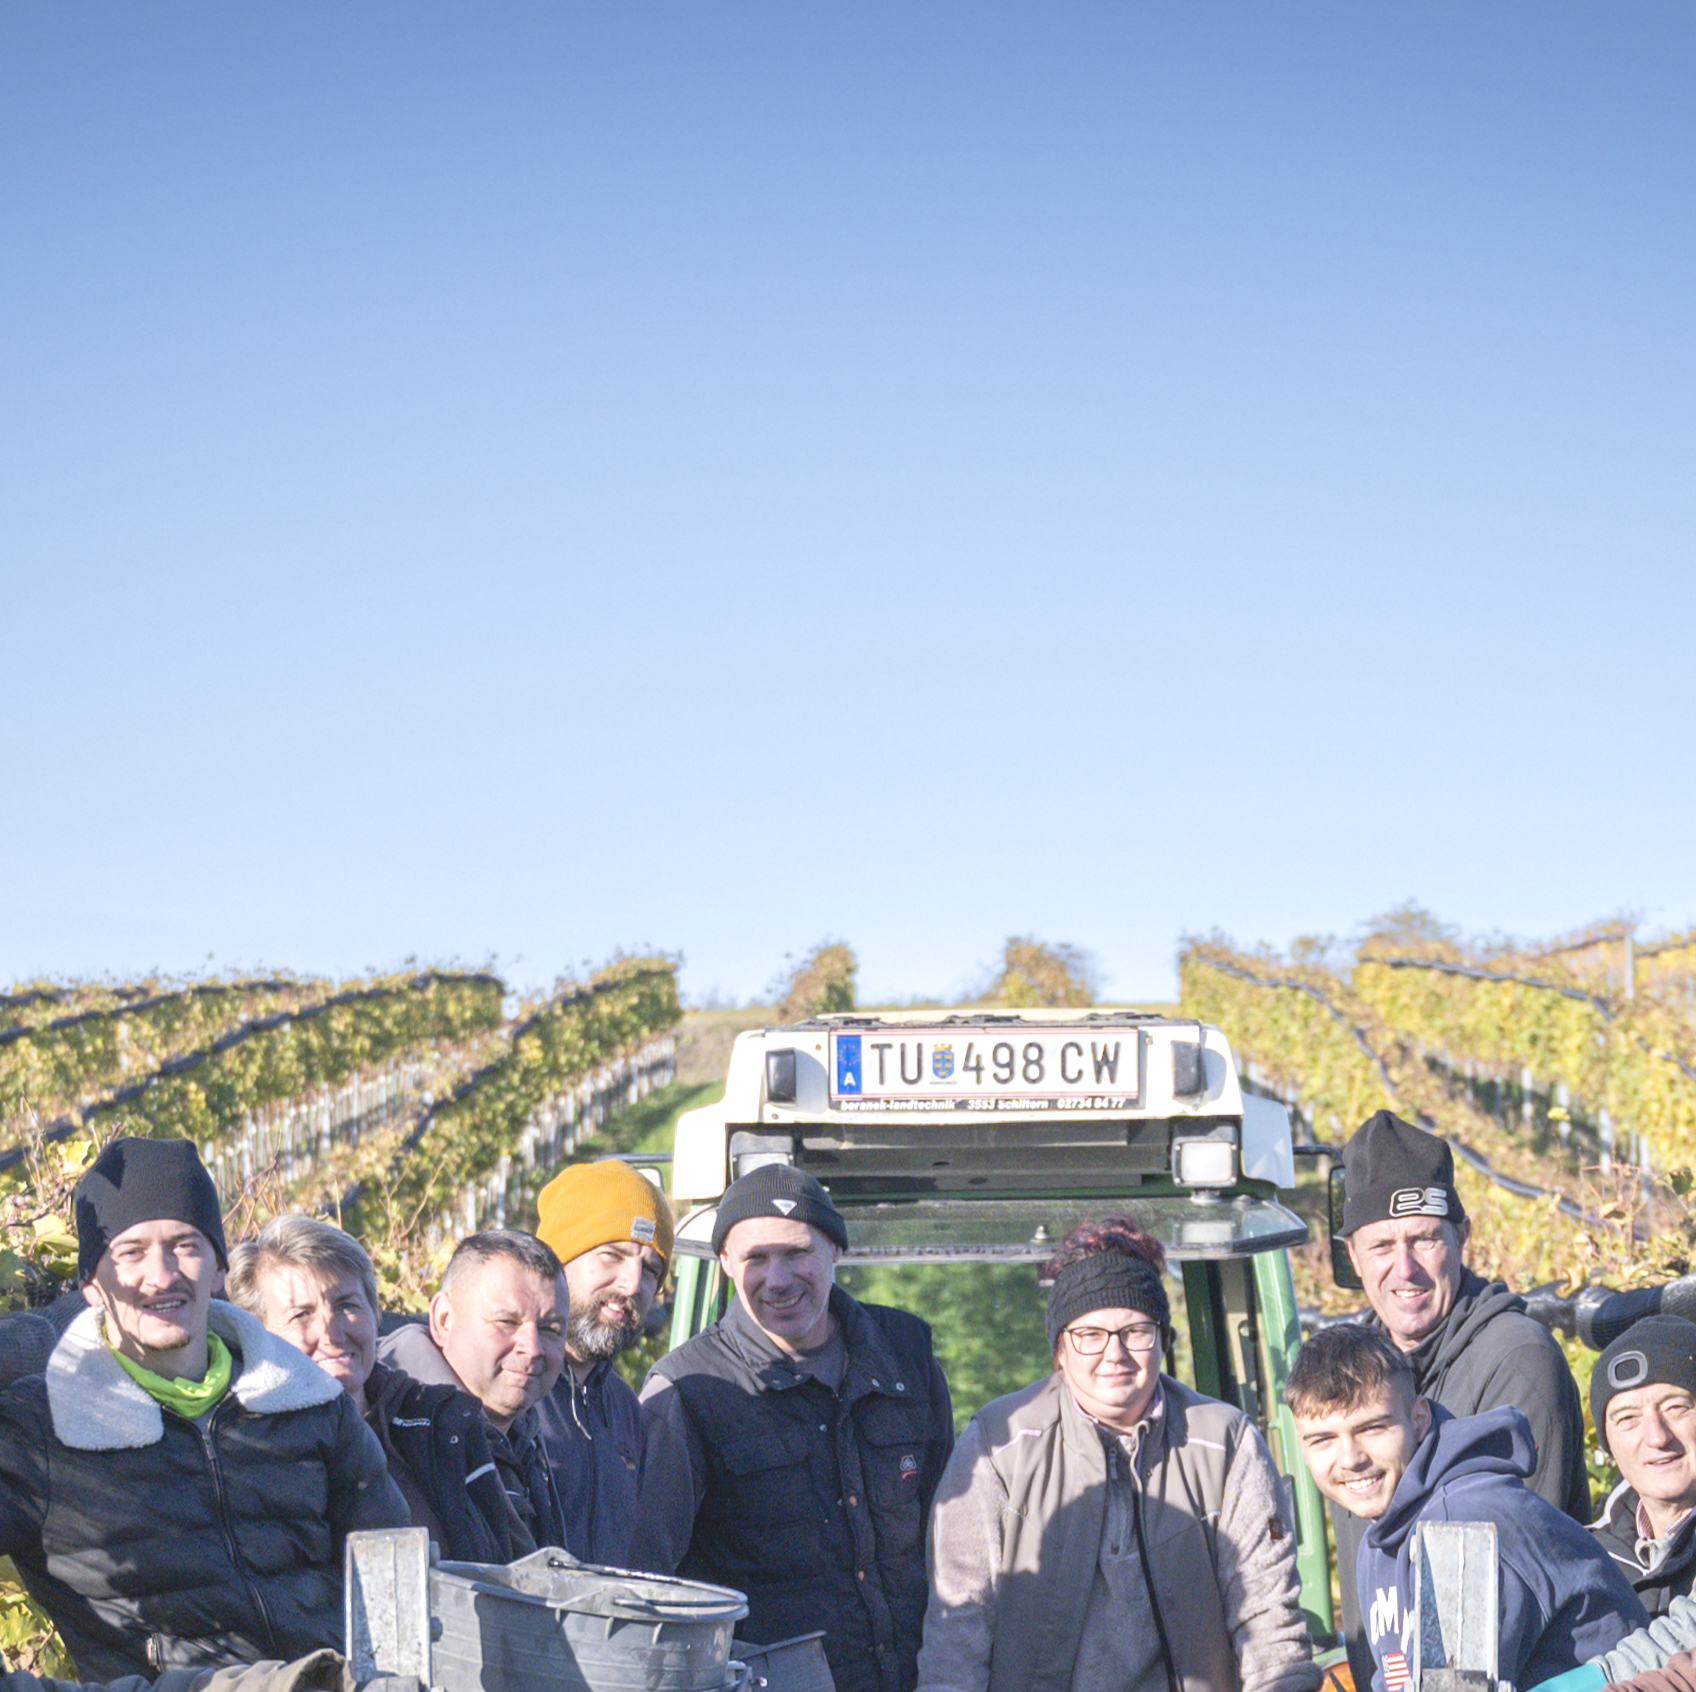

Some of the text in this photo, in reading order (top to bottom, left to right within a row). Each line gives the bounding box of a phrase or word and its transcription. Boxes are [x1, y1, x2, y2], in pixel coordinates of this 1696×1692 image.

[870, 1041, 1121, 1086] TU 498 CW
[843, 1072, 856, 1086] A
[967, 1099, 995, 1110] 3553
[1057, 1098, 1092, 1109] 02734
